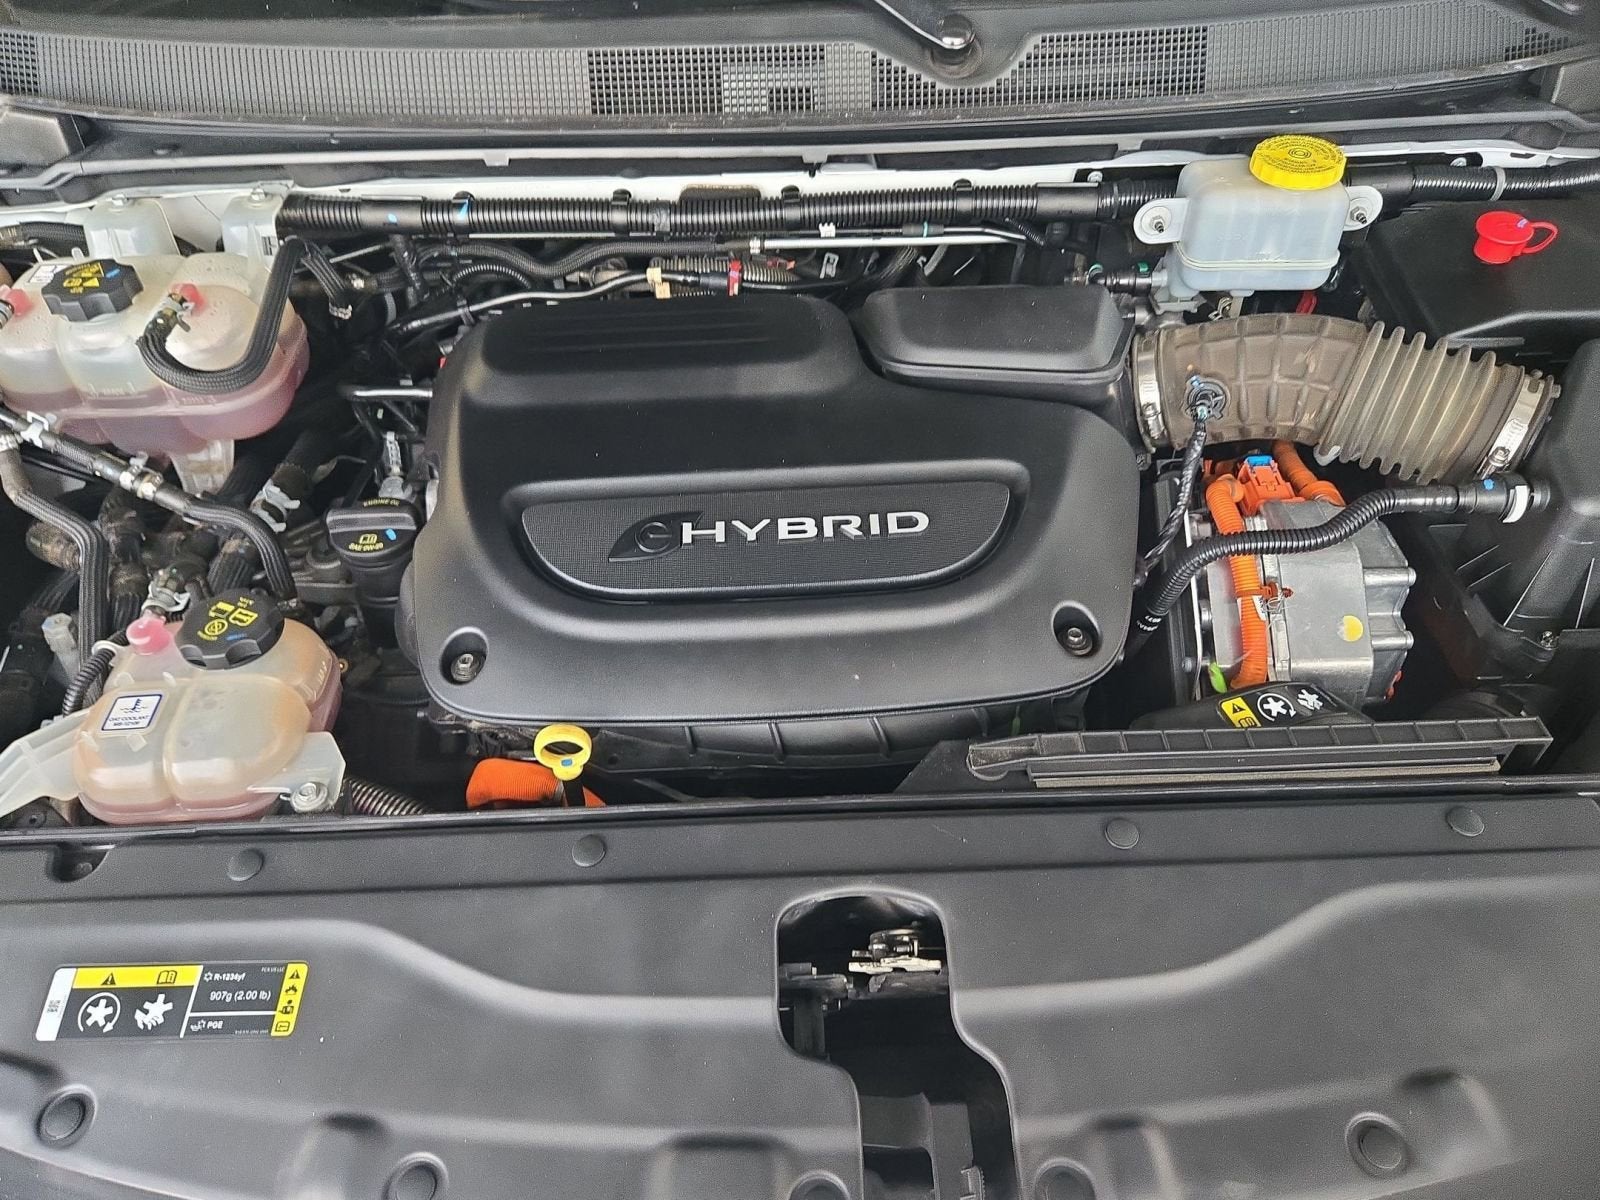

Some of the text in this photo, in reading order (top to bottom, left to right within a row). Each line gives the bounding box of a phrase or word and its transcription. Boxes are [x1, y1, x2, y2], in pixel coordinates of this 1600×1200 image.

[680, 510, 931, 546] HYBRID
[214, 973, 246, 982] R-1234yf
[209, 990, 272, 1003] 907g (2.00 lb)
[206, 1020, 224, 1030] POE
